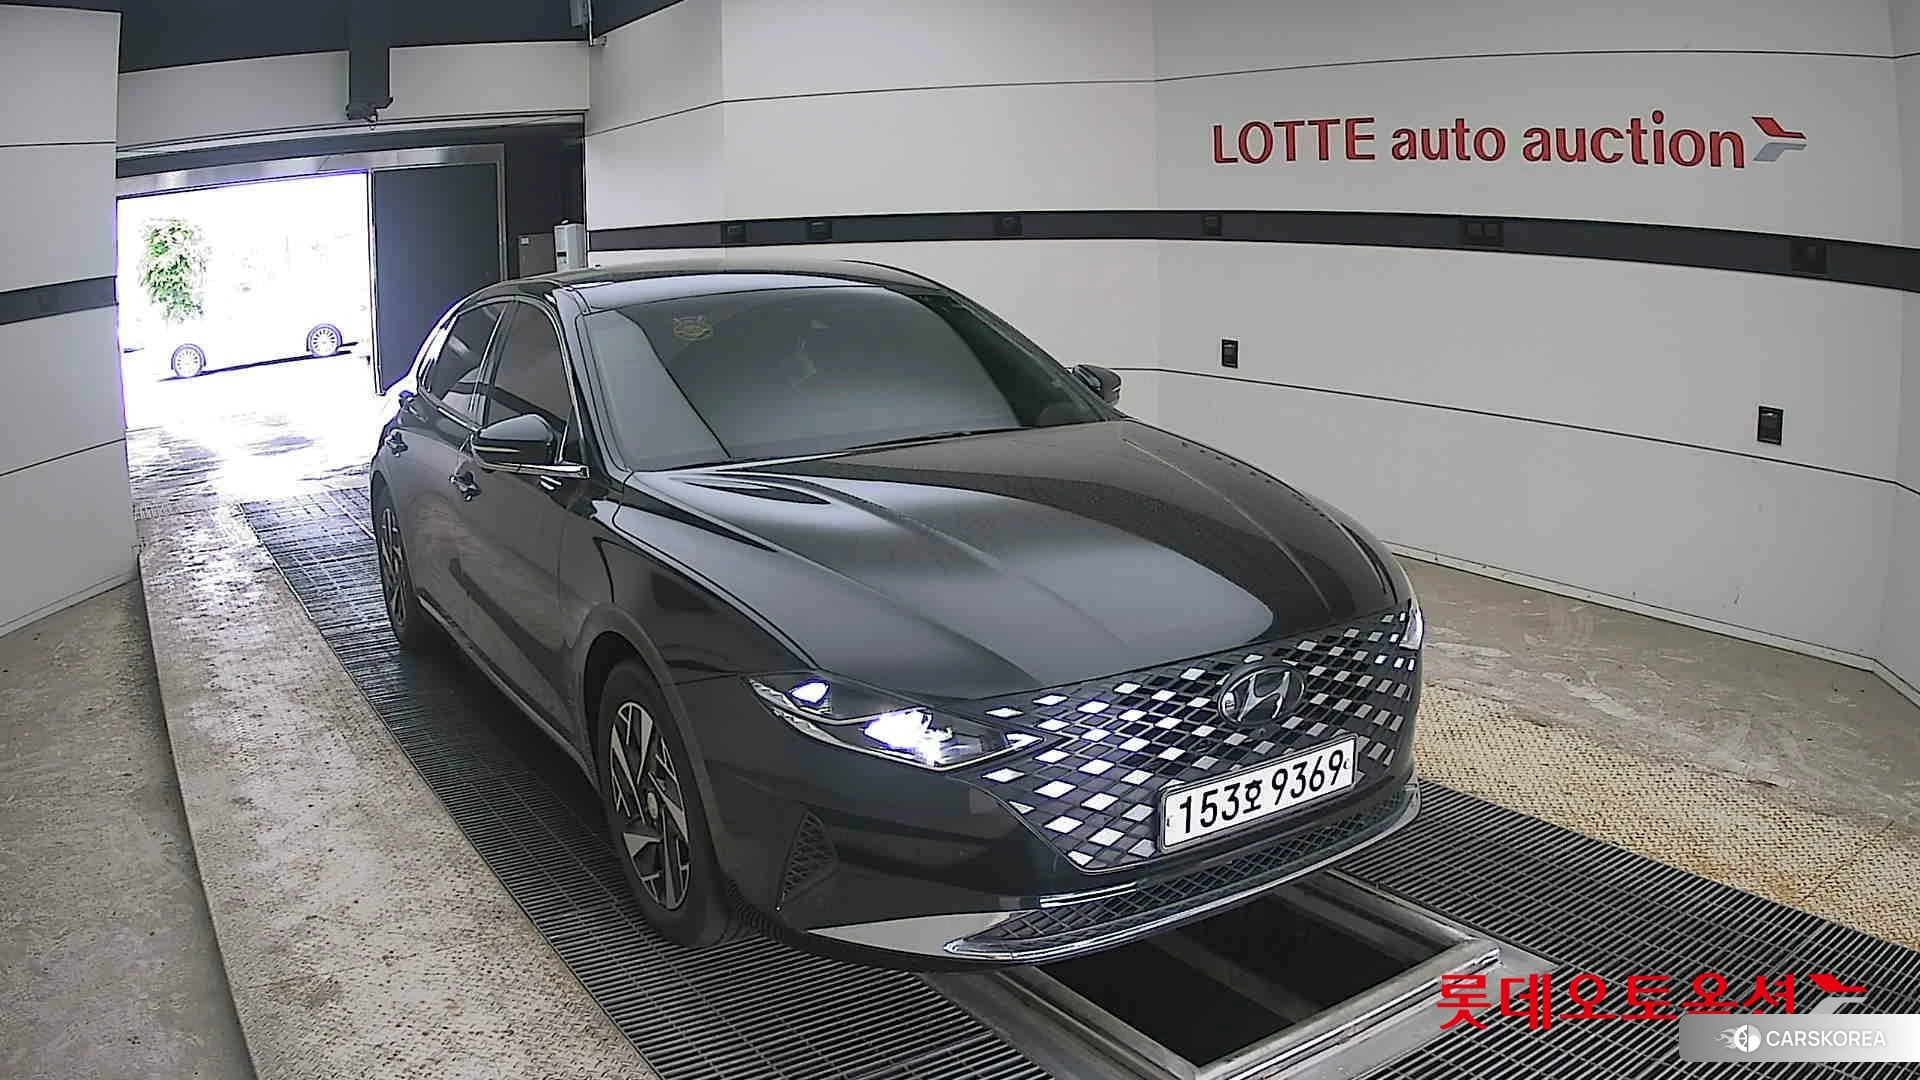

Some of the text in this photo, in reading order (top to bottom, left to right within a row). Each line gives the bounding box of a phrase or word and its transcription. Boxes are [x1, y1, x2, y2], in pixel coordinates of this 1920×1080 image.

[1213, 109, 1745, 169] LOTTE auto auction
[1179, 749, 1344, 834] 153호 9369
